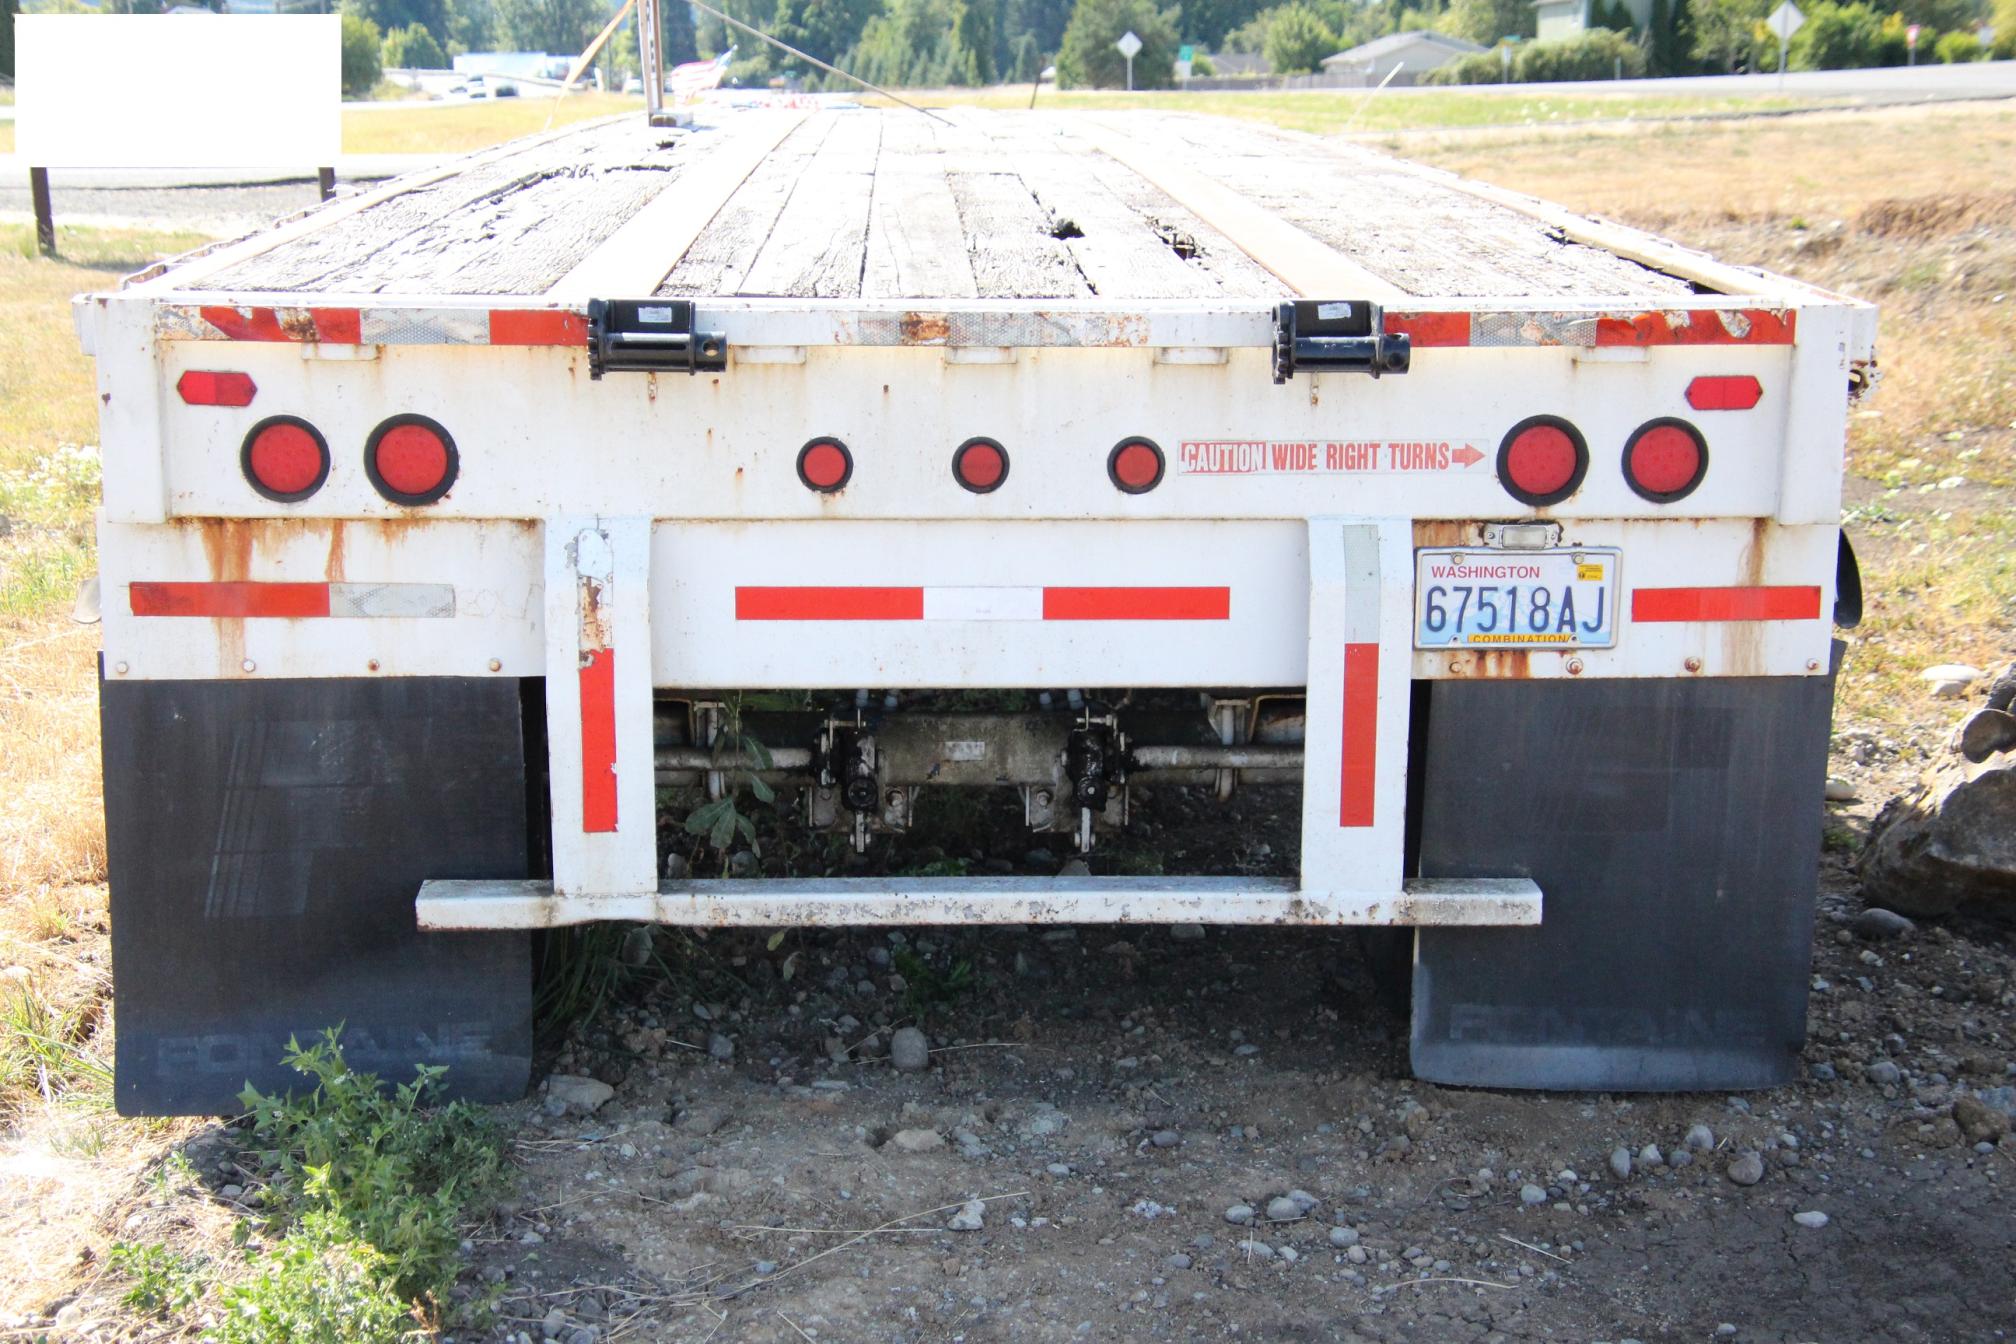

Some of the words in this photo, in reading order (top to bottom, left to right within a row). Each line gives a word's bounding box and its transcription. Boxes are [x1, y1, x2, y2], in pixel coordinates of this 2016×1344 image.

[1183, 442, 1264, 473] CAUTION
[1271, 442, 1318, 471] WIDE
[1325, 442, 1382, 471] RIGHT
[1387, 442, 1449, 470] TURNS
[1431, 565, 1541, 578] WASHINGTON
[1426, 585, 1605, 633] 67518AJ
[1472, 634, 1570, 643] COMBINATION
